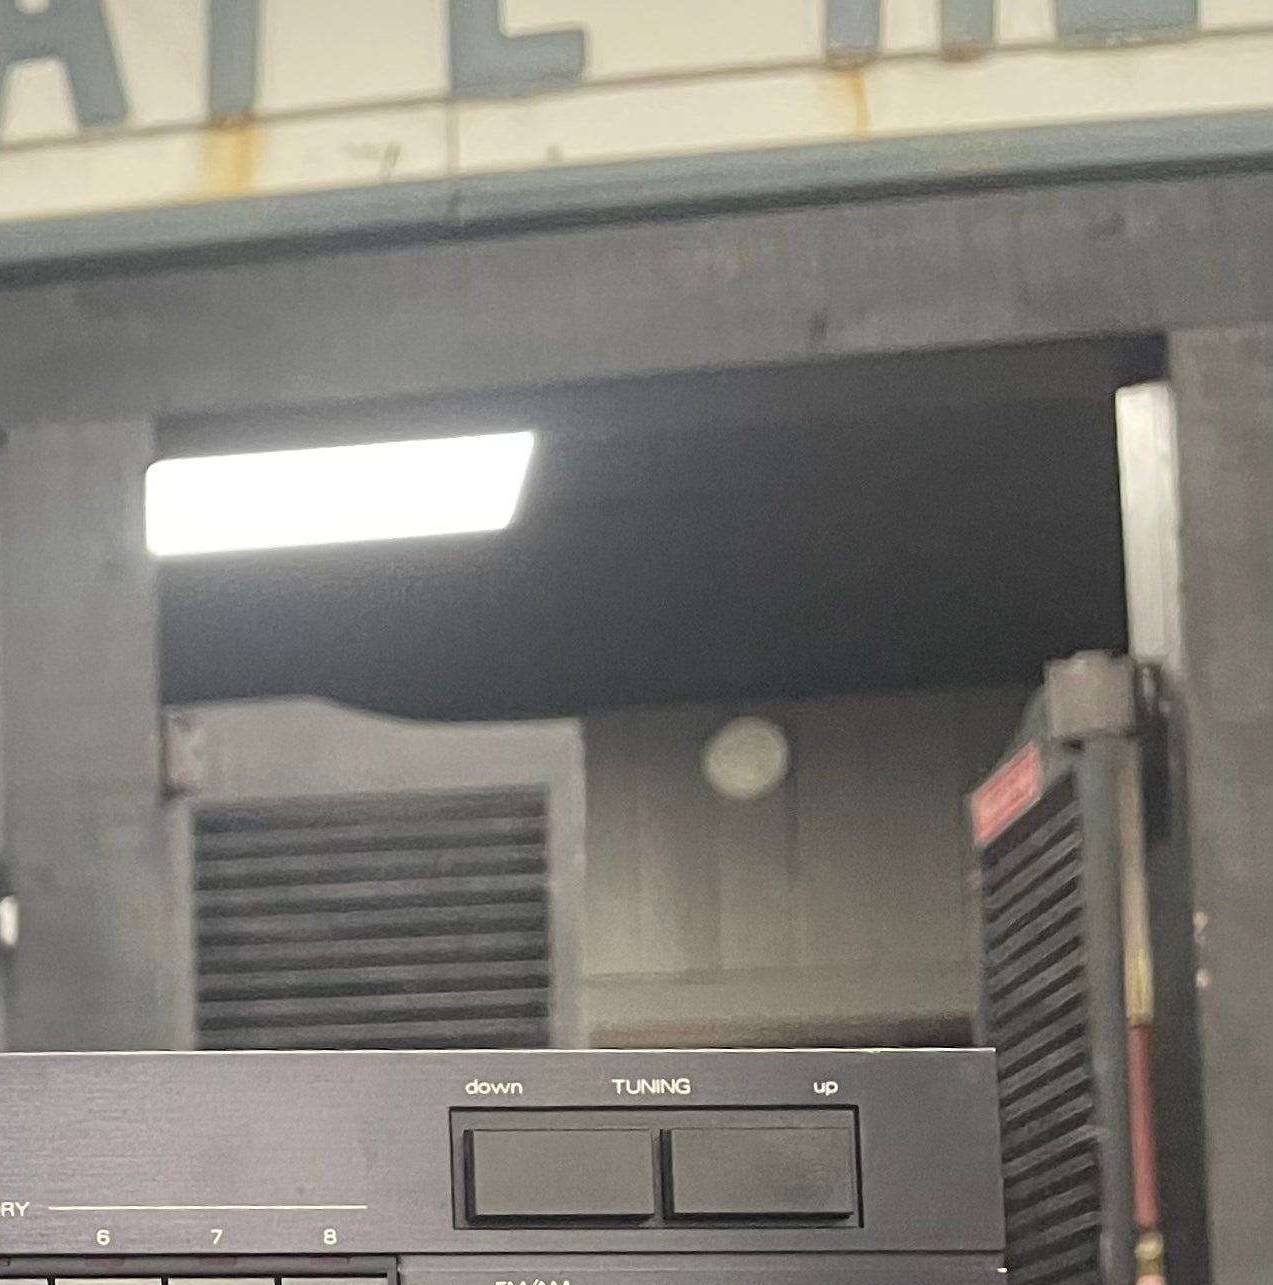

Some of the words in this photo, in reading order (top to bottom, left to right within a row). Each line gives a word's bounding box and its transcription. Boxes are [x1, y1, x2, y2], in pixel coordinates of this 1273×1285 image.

[465, 1079, 522, 1094] down
[612, 1078, 690, 1094] TUNING
[814, 1081, 838, 1096] up
[97, 1230, 110, 1245] 6
[211, 1229, 222, 1244] 7
[324, 1229, 336, 1244] 8
